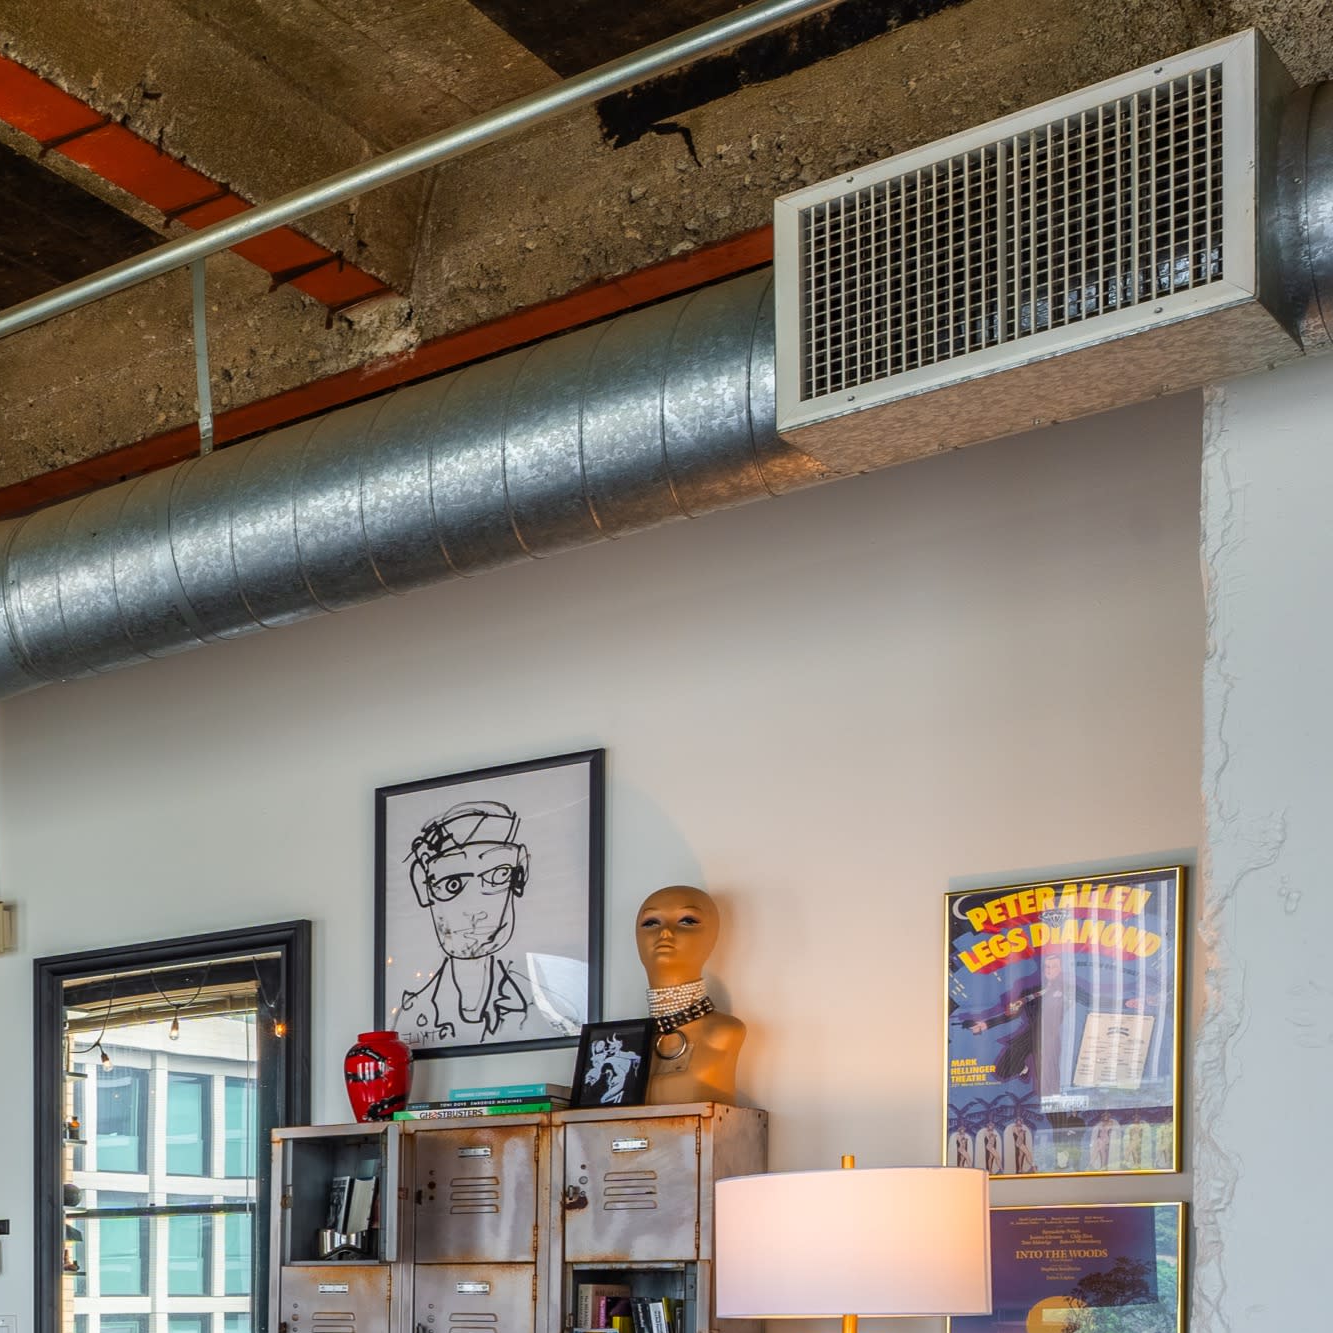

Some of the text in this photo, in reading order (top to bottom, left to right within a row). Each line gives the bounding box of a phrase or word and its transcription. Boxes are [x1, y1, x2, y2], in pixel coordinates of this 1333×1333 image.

[966, 883, 1152, 932] PETER ALLEN
[958, 927, 1028, 973] LEGS
[951, 1058, 977, 1067] MARK
[951, 1065, 996, 1075] HELLINGER
[951, 1074, 987, 1084] THEATRE
[1015, 1249, 1108, 1259] INTO THE WOODS
